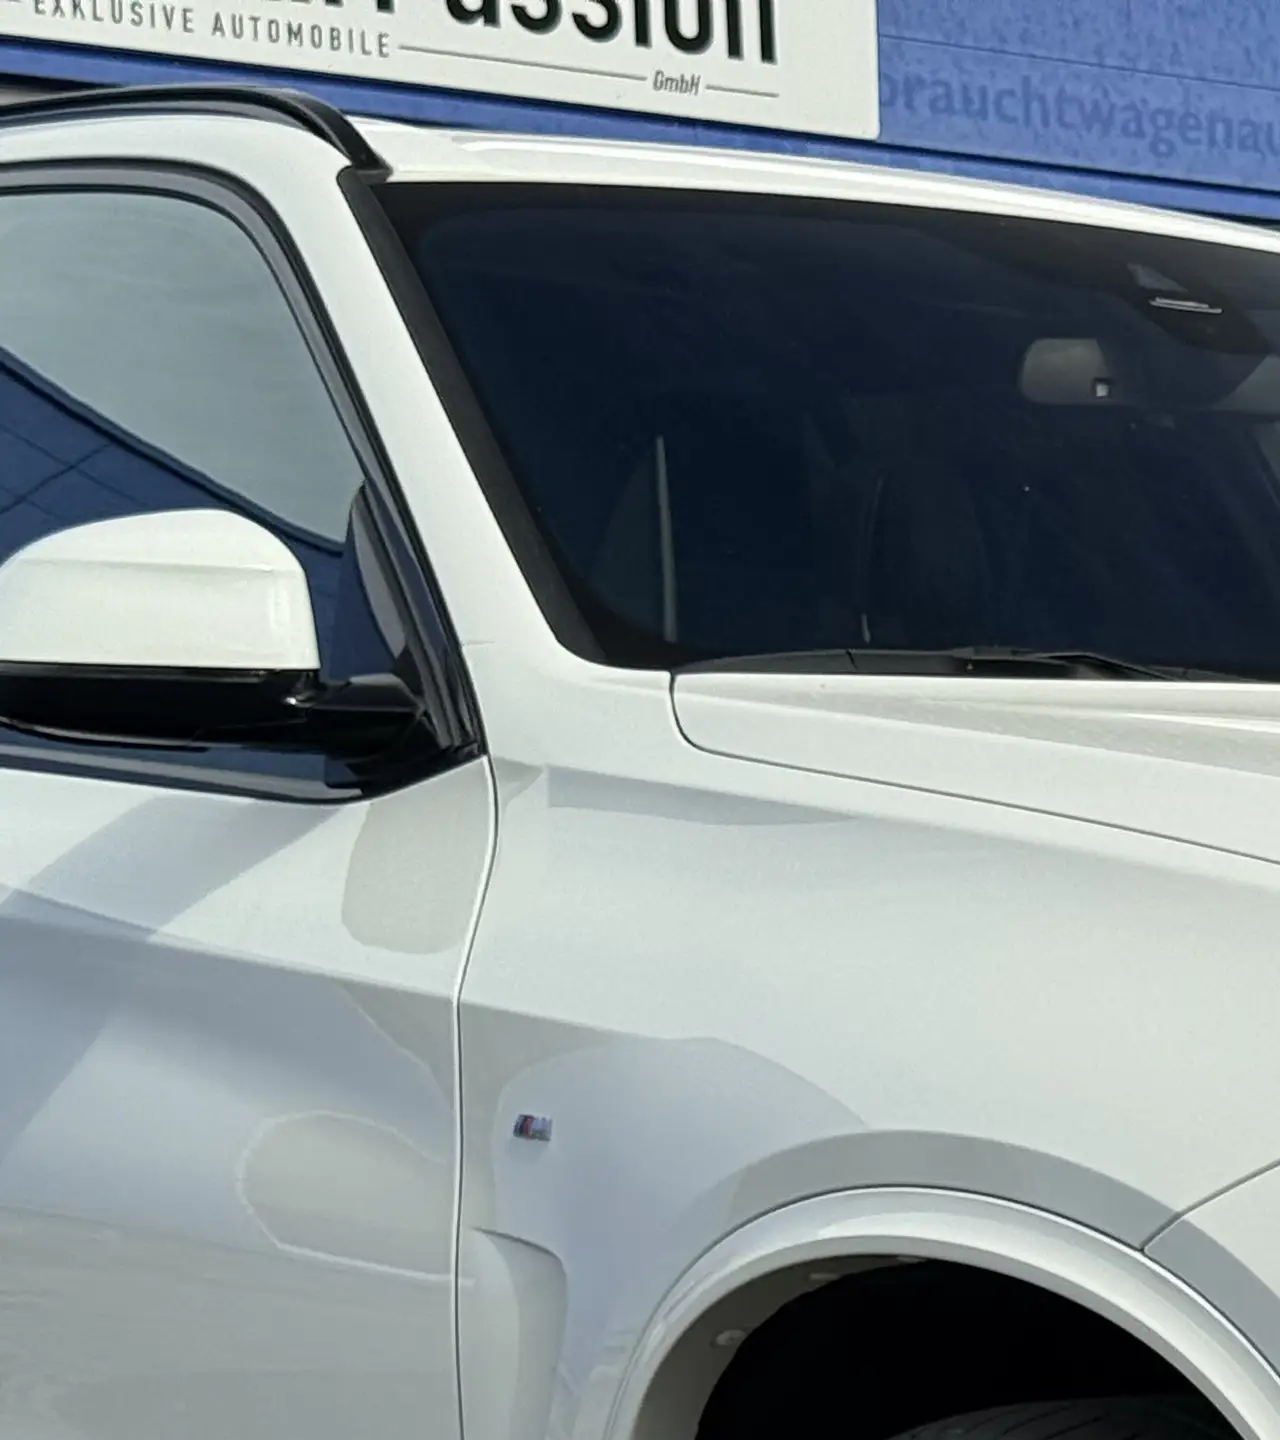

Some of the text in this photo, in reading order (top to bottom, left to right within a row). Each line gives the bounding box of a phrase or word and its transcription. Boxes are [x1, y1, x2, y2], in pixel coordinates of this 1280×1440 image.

[33, 0, 195, 34] EXKLUSIVE
[211, 11, 391, 58] AUTOMOBILE
[653, 69, 700, 97] GmbH
